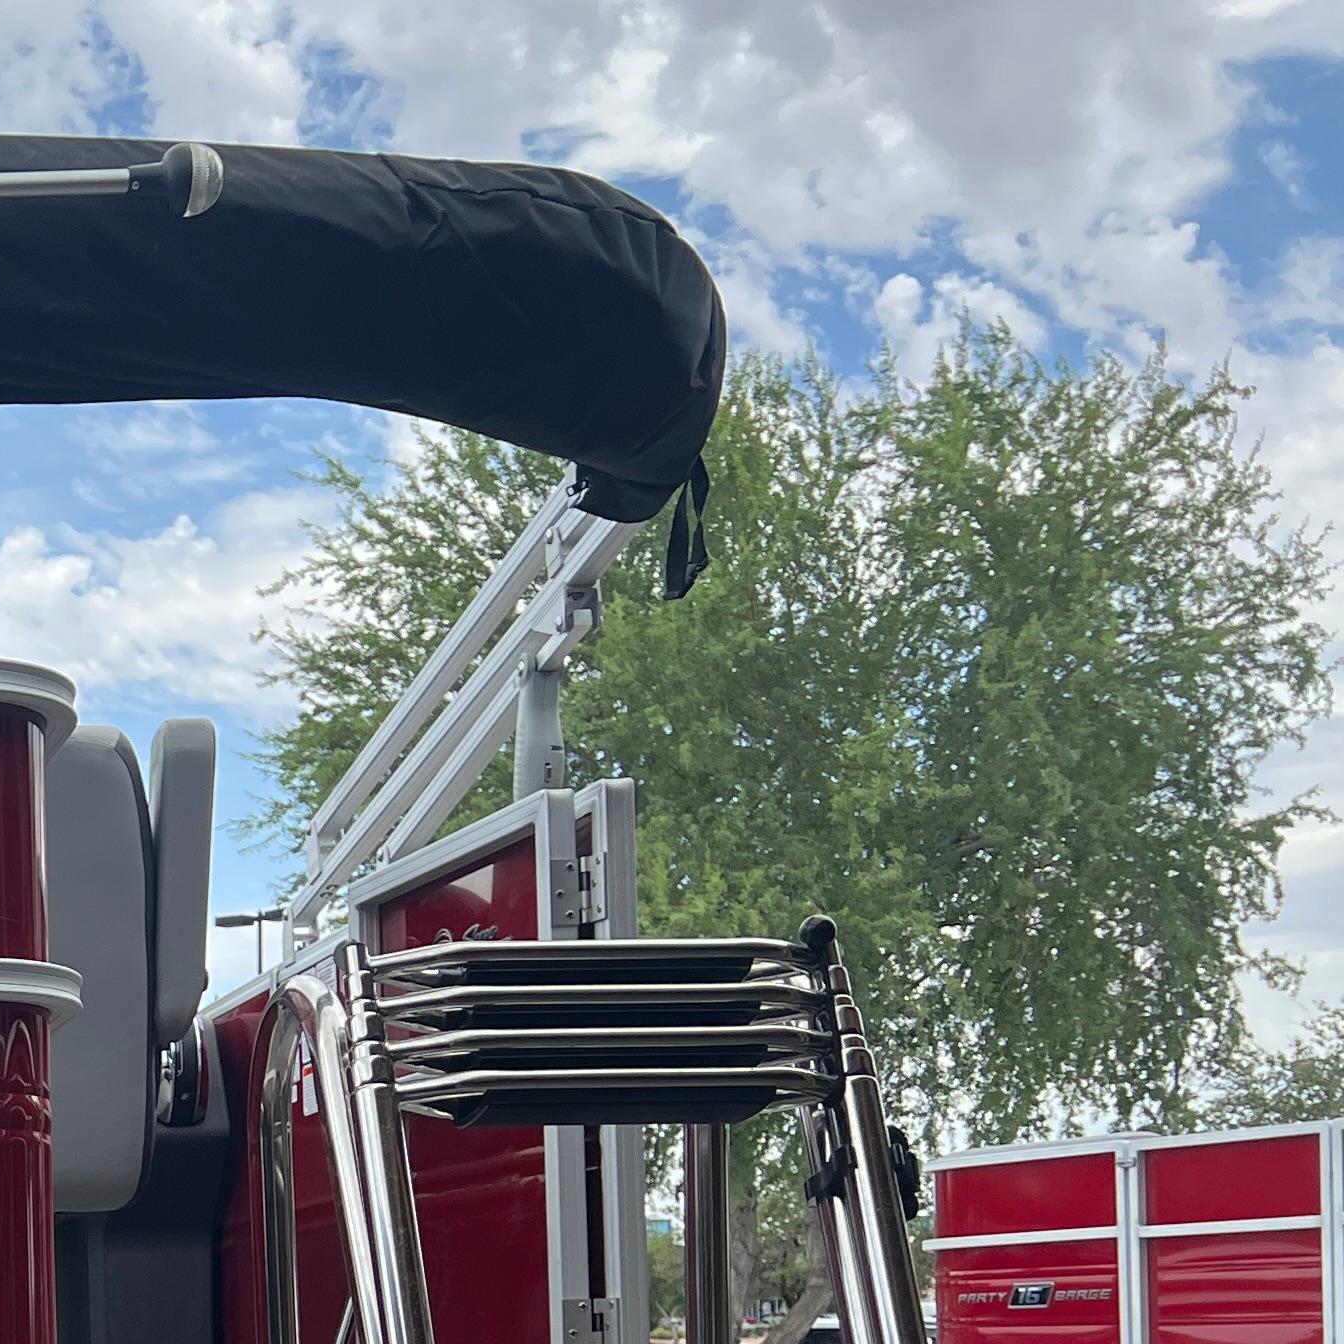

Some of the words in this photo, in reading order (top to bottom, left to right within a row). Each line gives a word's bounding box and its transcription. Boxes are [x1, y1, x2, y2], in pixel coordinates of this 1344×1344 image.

[958, 1292, 1007, 1304] PARTY
[1018, 1286, 1043, 1304] 16
[1055, 1288, 1112, 1301] BARGE
